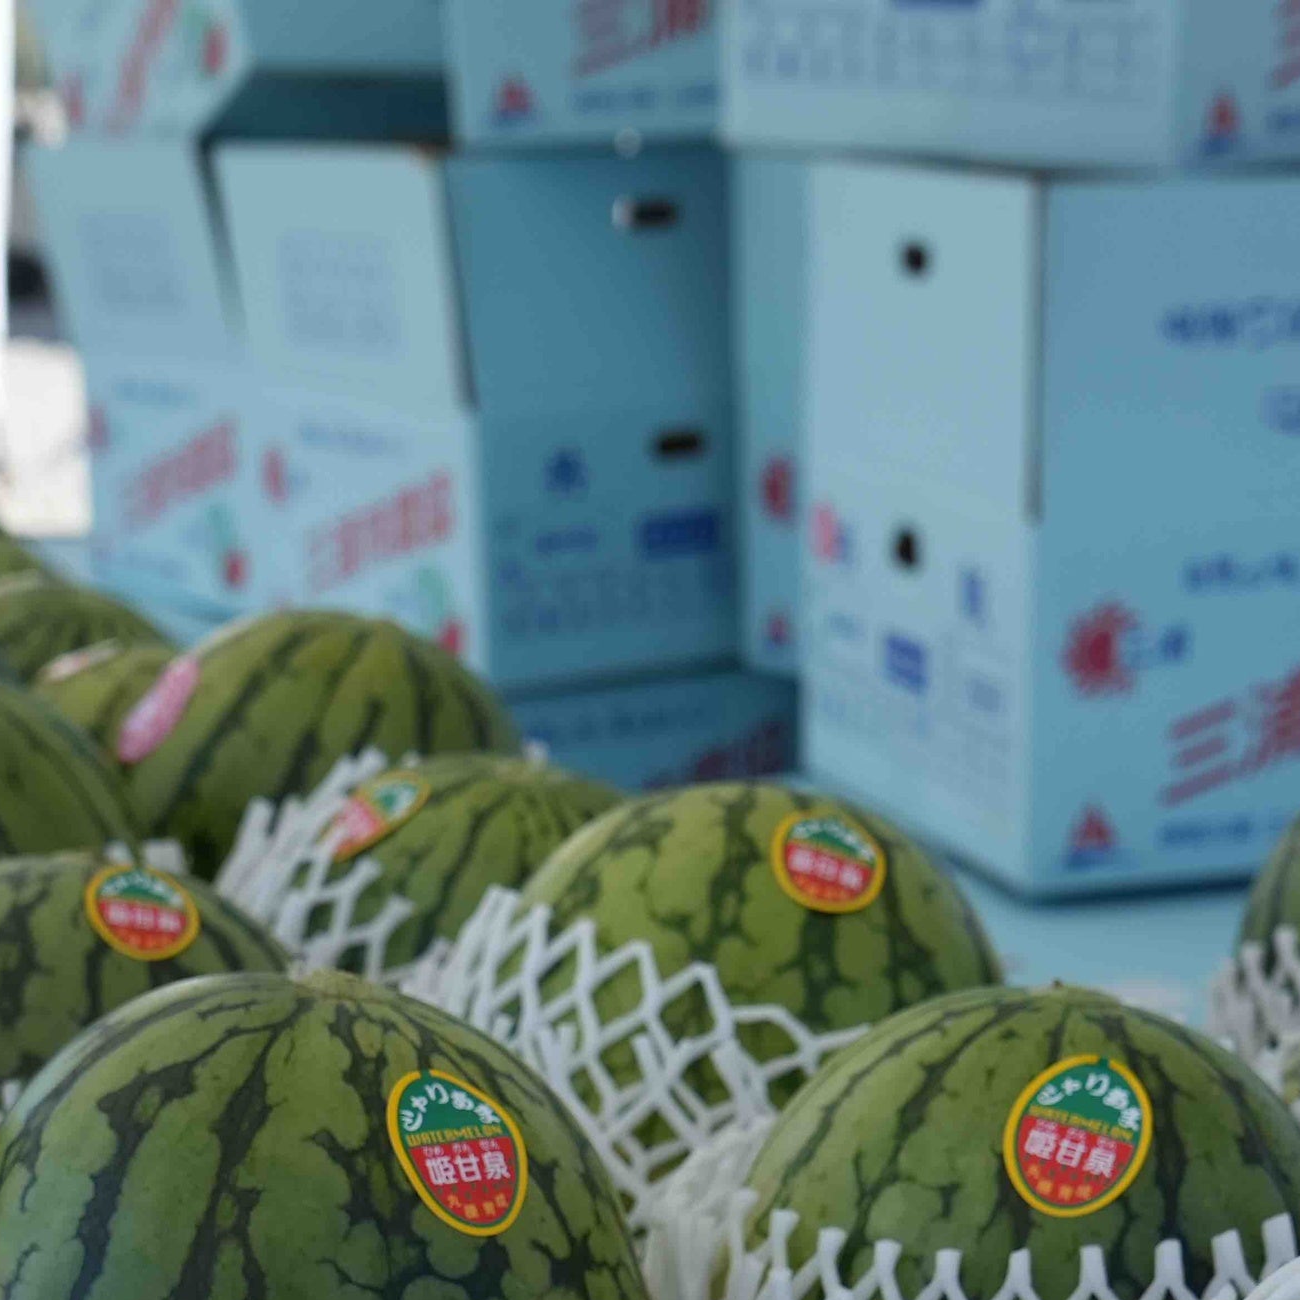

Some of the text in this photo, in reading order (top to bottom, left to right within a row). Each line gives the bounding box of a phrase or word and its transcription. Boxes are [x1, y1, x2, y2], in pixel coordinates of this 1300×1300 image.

[406, 1124, 504, 1147] WATERMELON
[425, 1150, 511, 1186] 姫甘泉
